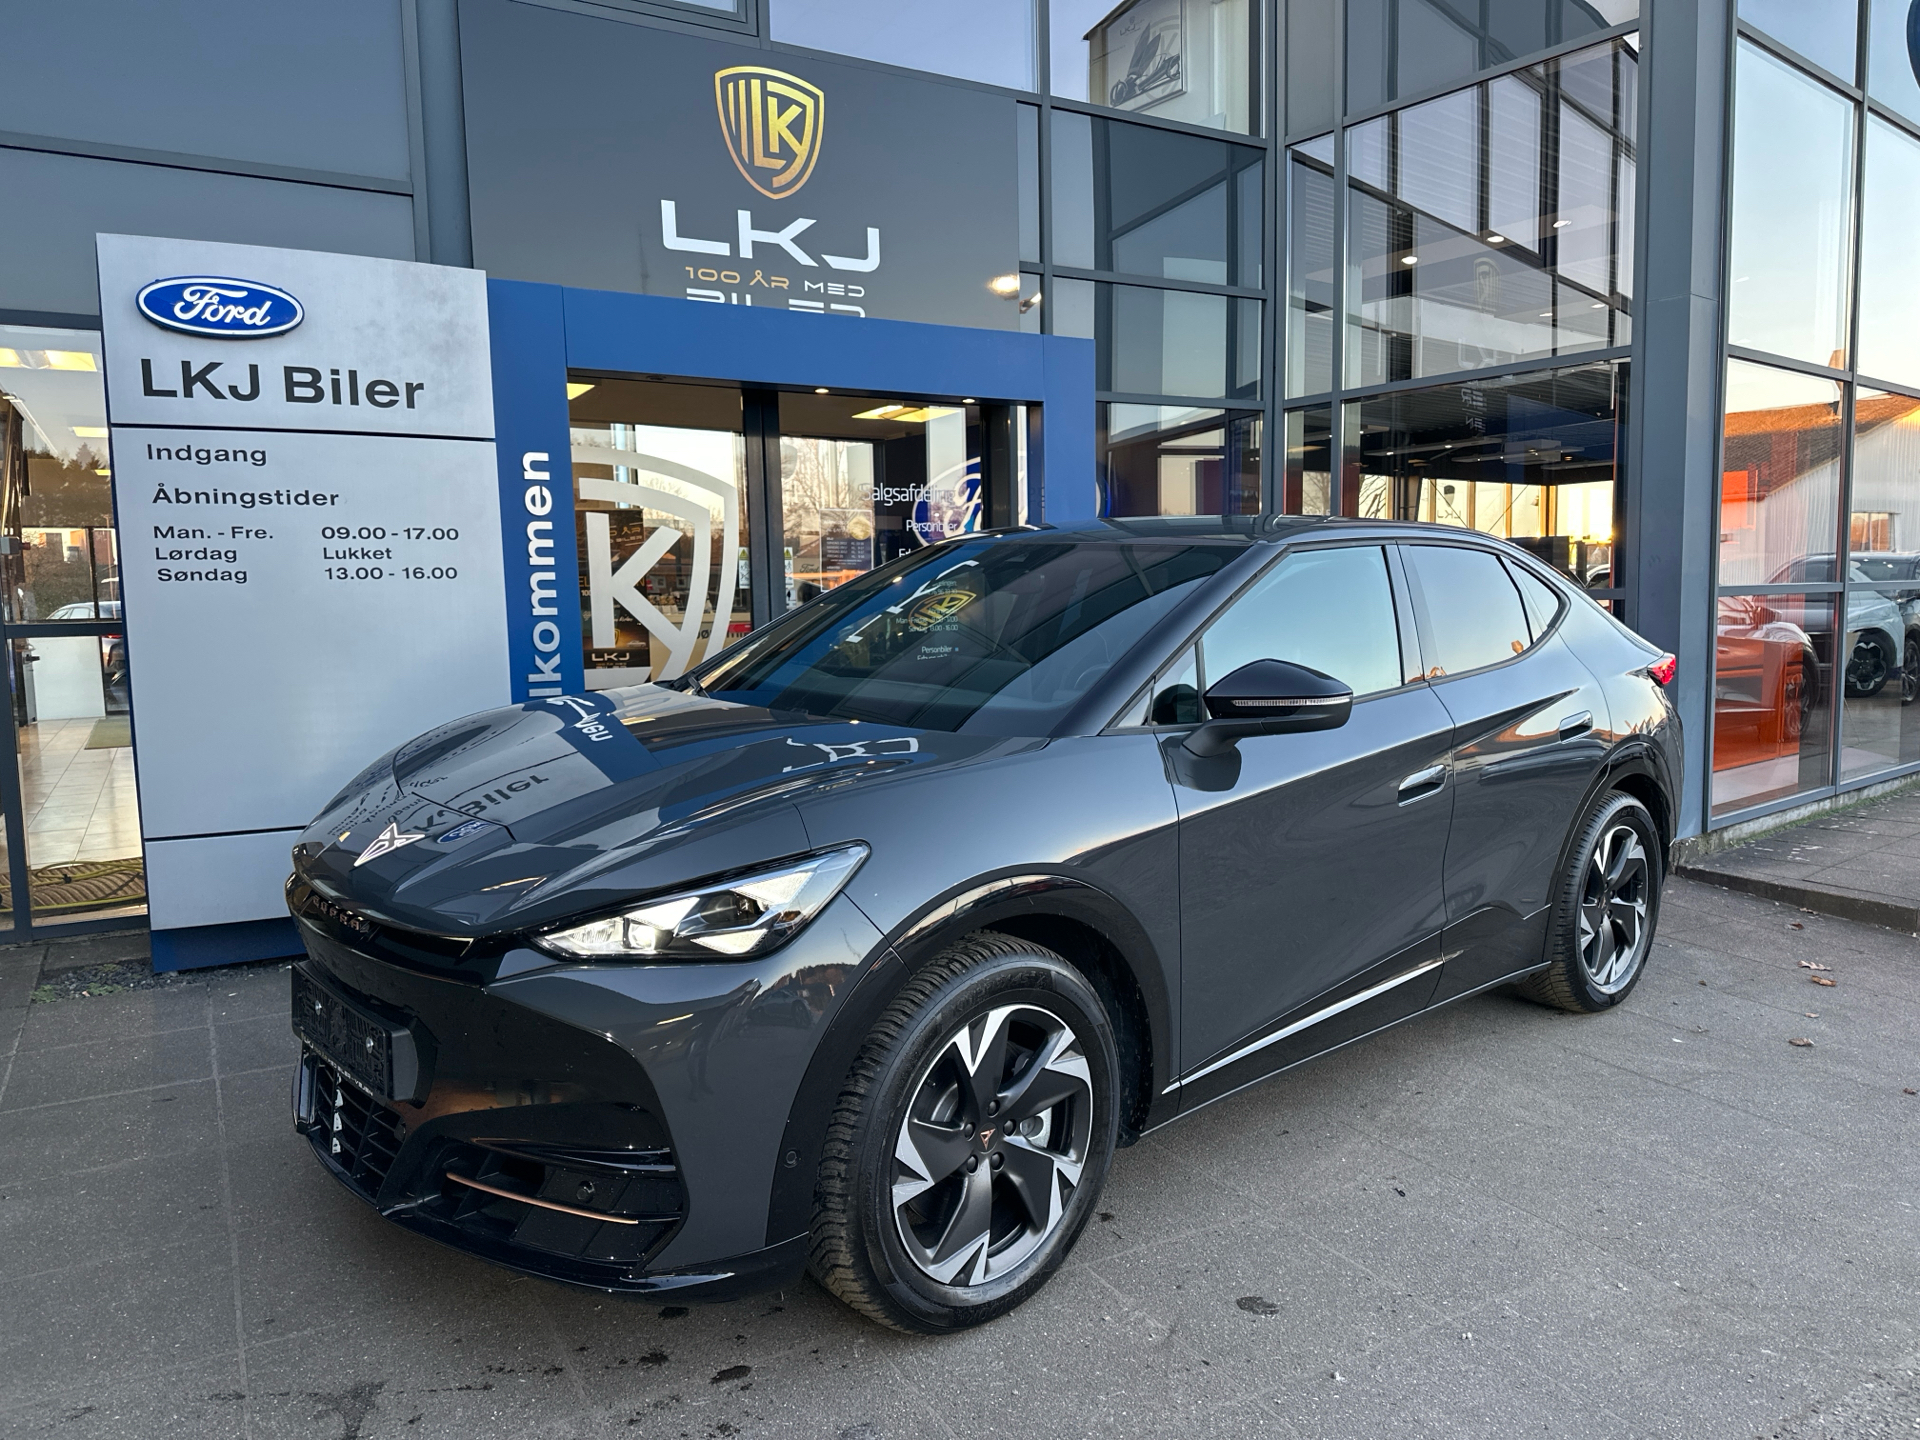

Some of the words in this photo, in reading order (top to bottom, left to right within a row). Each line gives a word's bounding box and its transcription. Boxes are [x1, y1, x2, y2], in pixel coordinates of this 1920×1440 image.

[661, 199, 880, 273] LKJ
[685, 266, 741, 284] 100
[804, 280, 866, 298] MED
[173, 285, 273, 327] Ford
[141, 358, 261, 402] LKJ
[283, 365, 425, 410] Biler
[147, 443, 267, 467] Indgang
[152, 482, 340, 509] Åbningstider
[153, 525, 212, 539] Man.
[231, 526, 274, 540] Fre.
[321, 526, 387, 540] 09.00
[403, 527, 460, 541] 17.00
[906, 519, 958, 532] Personber
[155, 546, 238, 563] Lørdag
[323, 546, 393, 560] Lukket
[157, 567, 249, 584] Søndag
[324, 566, 384, 580] 13.00
[402, 566, 458, 580] 16.00
[591, 652, 630, 662] LKJ
